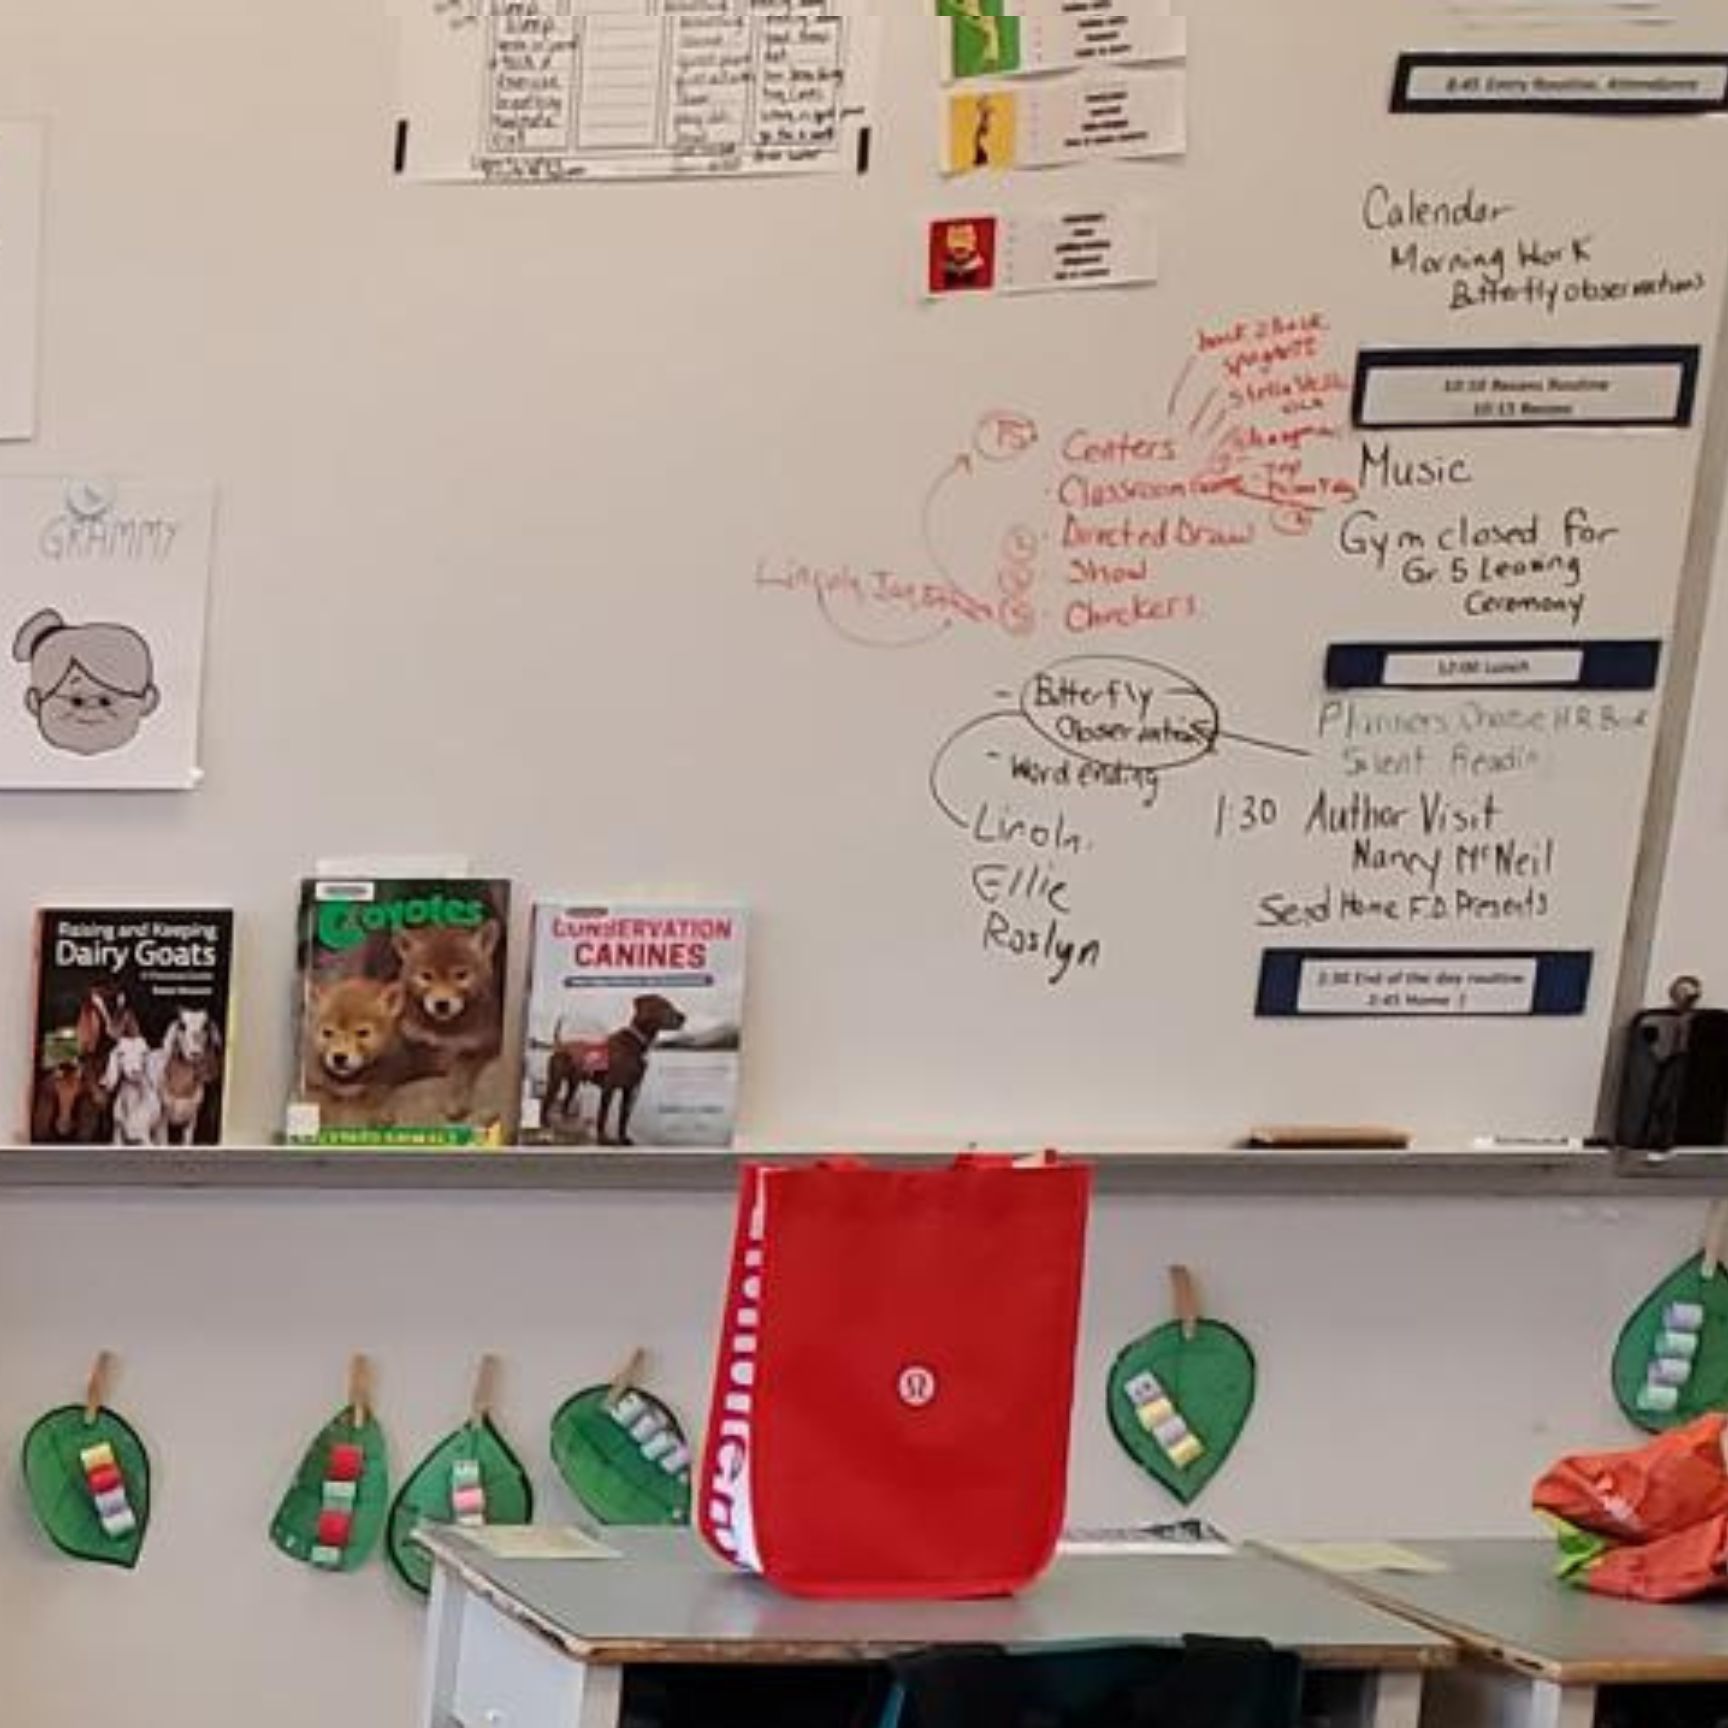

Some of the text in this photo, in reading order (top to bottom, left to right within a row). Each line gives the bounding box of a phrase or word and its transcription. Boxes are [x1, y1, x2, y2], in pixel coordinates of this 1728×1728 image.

[1391, 235, 1591, 279] Morning Work
[1063, 430, 1176, 461] Centers
[1359, 443, 1472, 488] Music
[40, 520, 183, 562] GRAMMY
[1339, 511, 1425, 566] Gym
[1439, 511, 1538, 547] closed
[1564, 508, 1618, 542] for
[1464, 592, 1584, 626] Ceremony
[1306, 792, 1409, 833] Author
[1419, 791, 1503, 833] Visit
[1354, 840, 1441, 886] Nancy
[319, 896, 484, 949] Coyotes
[553, 918, 732, 938] CONSERVATION
[1257, 890, 1331, 927] Send
[1340, 893, 1399, 920] Home
[119, 923, 146, 937] and
[56, 940, 216, 973] Dairy Goats
[575, 943, 706, 968] CANINES
